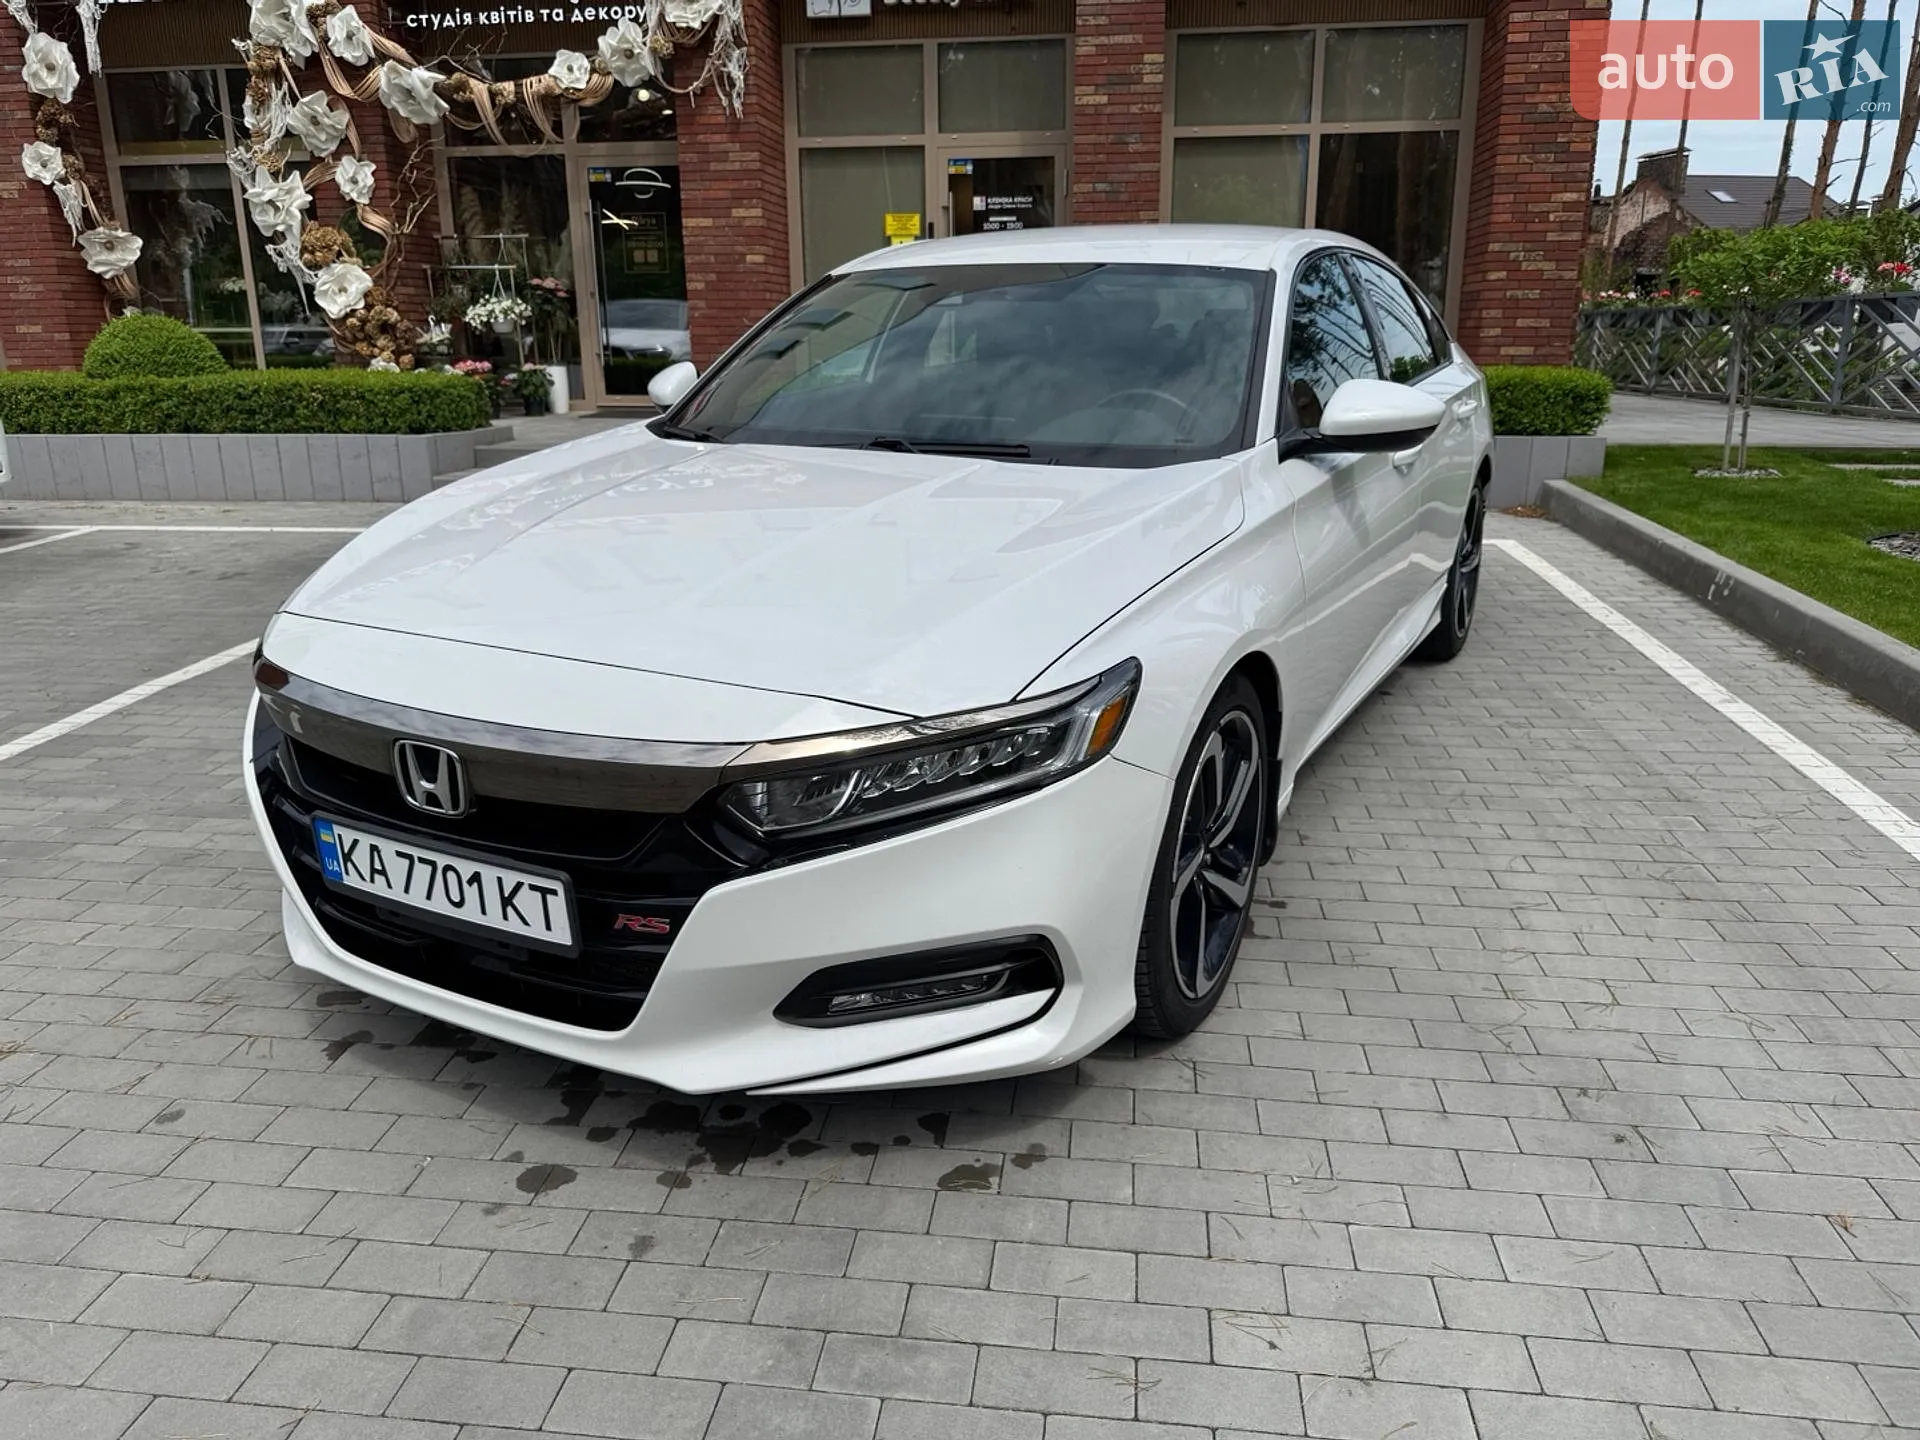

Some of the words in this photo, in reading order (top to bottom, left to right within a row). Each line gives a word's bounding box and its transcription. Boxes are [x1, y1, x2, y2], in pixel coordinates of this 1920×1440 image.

[406, 7, 472, 30] студія
[478, 5, 535, 25] квітів
[539, 8, 564, 22] та
[571, 5, 647, 23] декору
[325, 856, 342, 873] UA
[613, 913, 671, 933] RS
